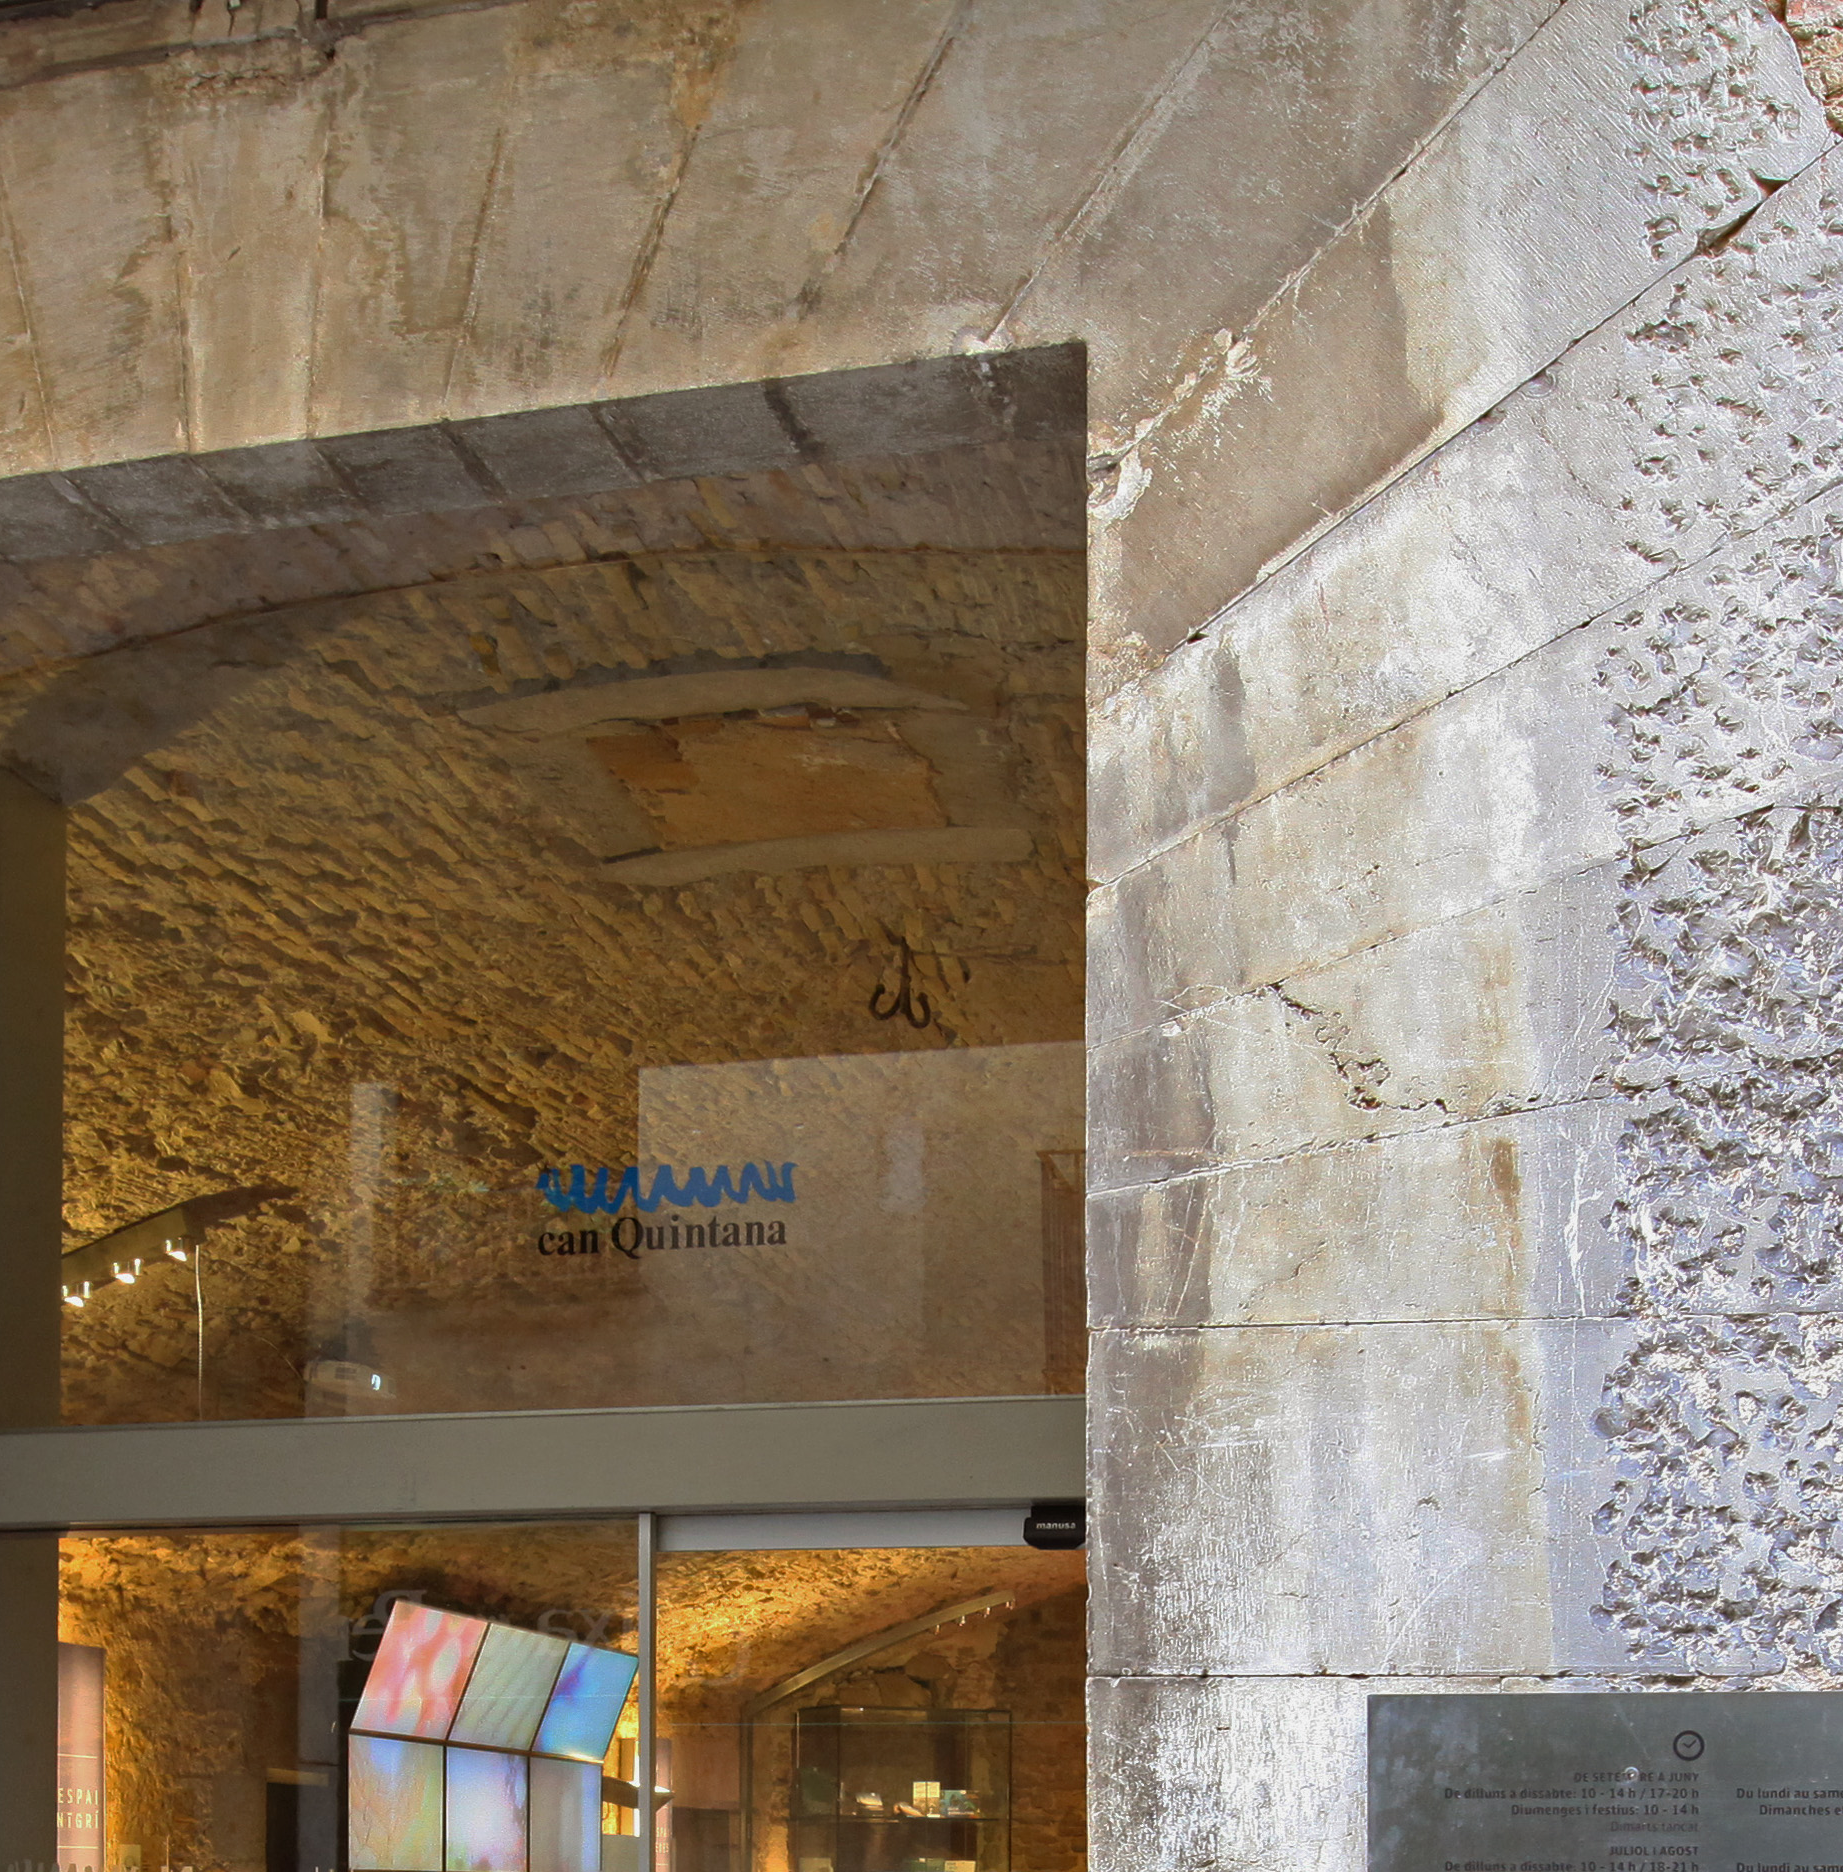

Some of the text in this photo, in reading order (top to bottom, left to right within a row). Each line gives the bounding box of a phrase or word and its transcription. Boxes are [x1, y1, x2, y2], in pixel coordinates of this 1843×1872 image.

[538, 1215, 787, 1259] can Quintana
[1036, 1522, 1076, 1530] manusa
